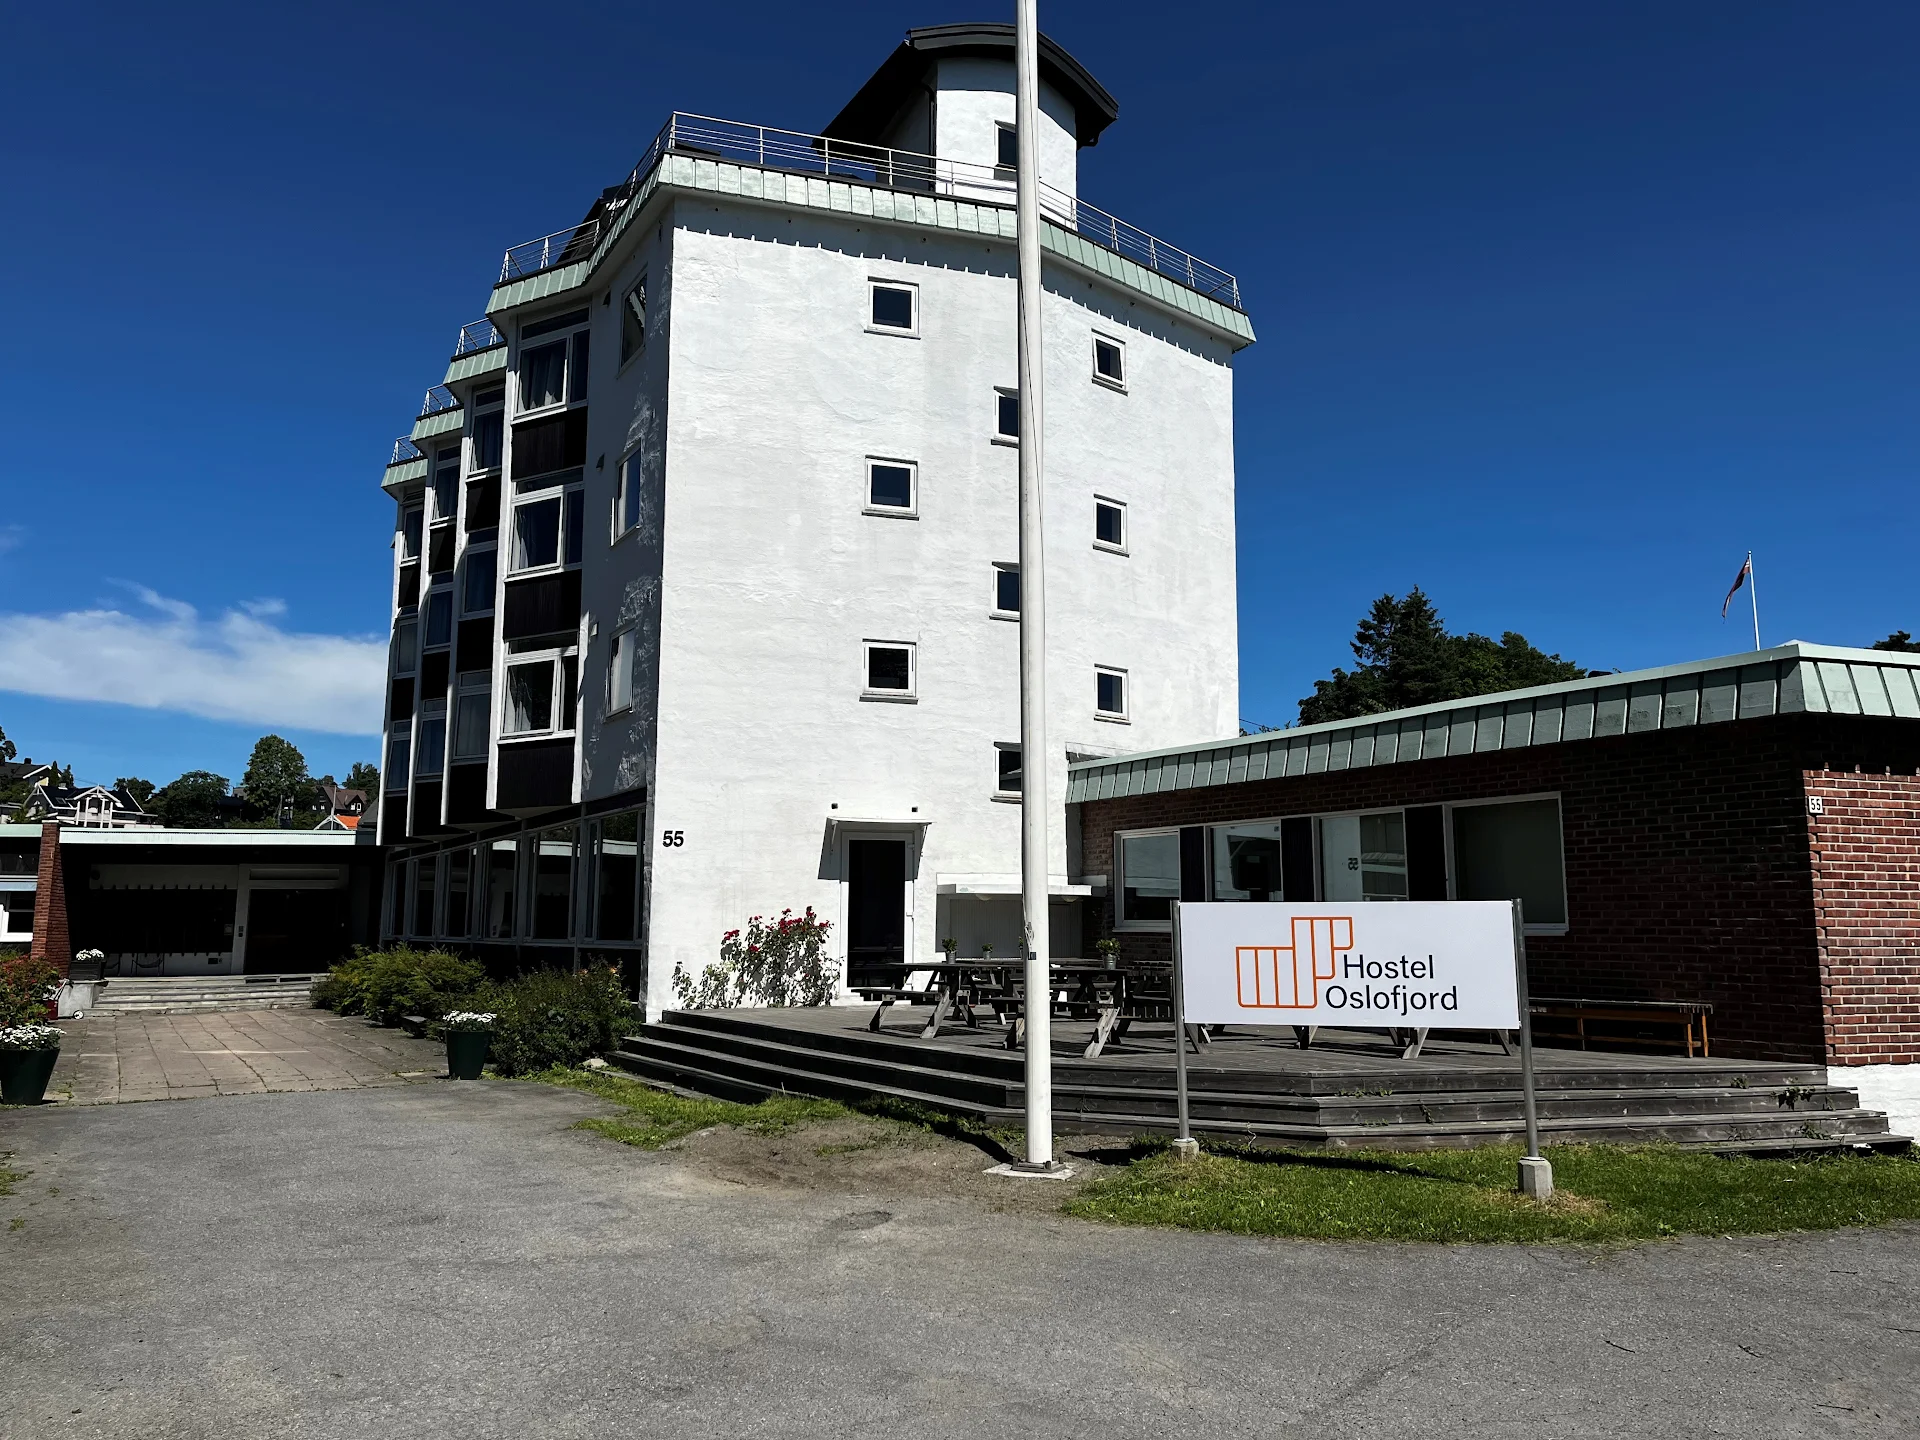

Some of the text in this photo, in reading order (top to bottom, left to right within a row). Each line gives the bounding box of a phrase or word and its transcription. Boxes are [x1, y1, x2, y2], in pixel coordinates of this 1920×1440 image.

[1810, 798, 1821, 811] 55
[662, 830, 684, 848] 55
[1343, 954, 1434, 980] Hostel
[1325, 985, 1458, 1016] Oslofjord
